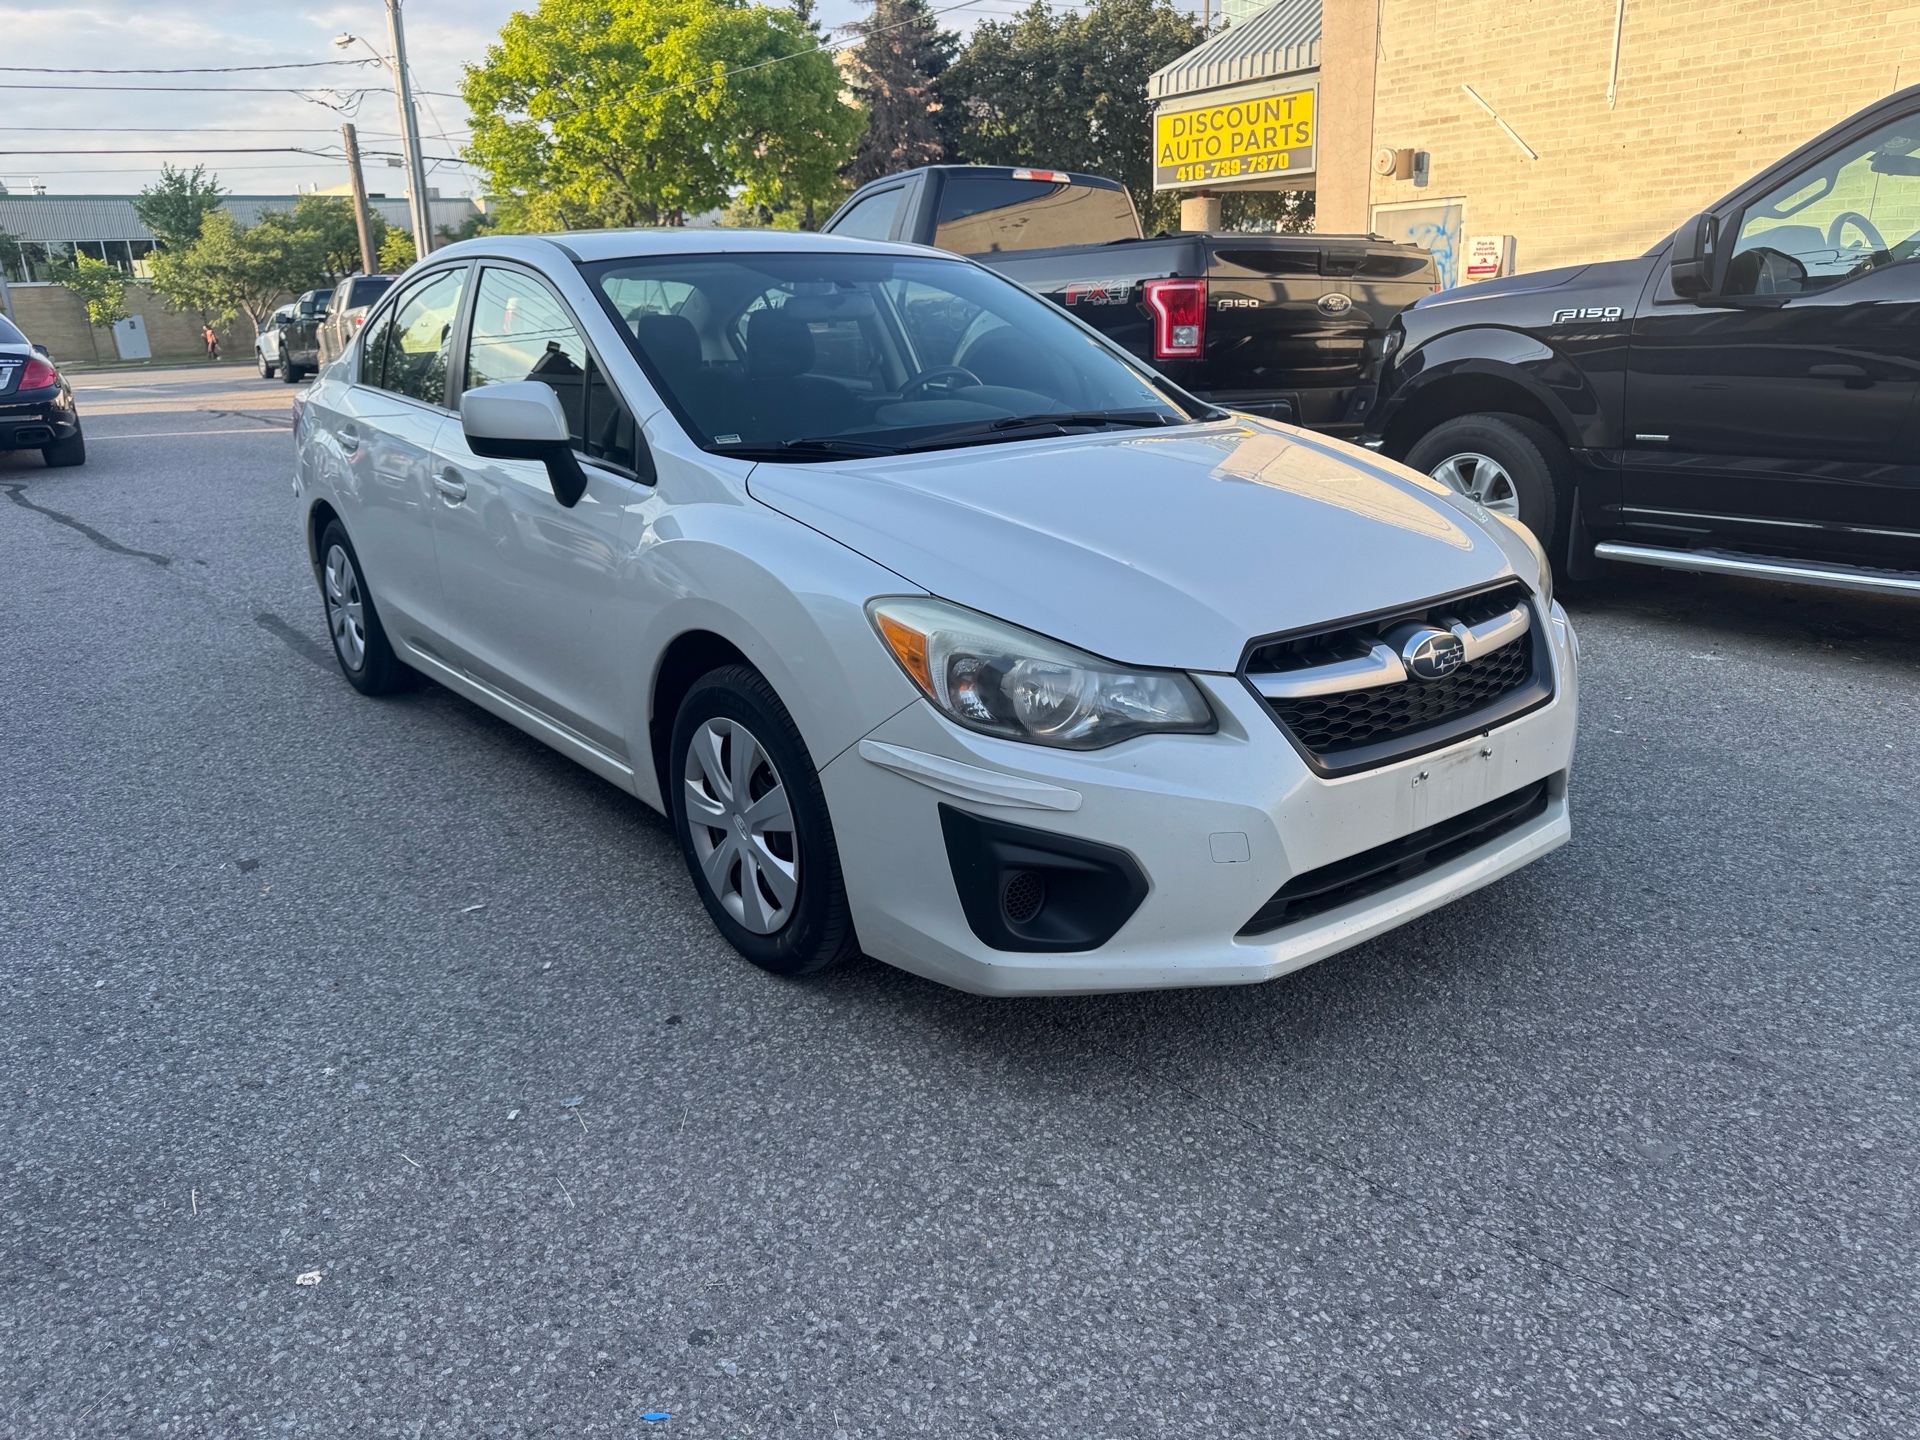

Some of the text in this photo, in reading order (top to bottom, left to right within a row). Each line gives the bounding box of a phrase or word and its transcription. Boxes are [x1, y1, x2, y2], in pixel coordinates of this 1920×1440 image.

[1173, 96, 1297, 138] DISCOUNT
[1160, 120, 1310, 164] AUTO PARTS
[1176, 152, 1289, 182] 416-739-7370
[1066, 279, 1130, 306] FX4
